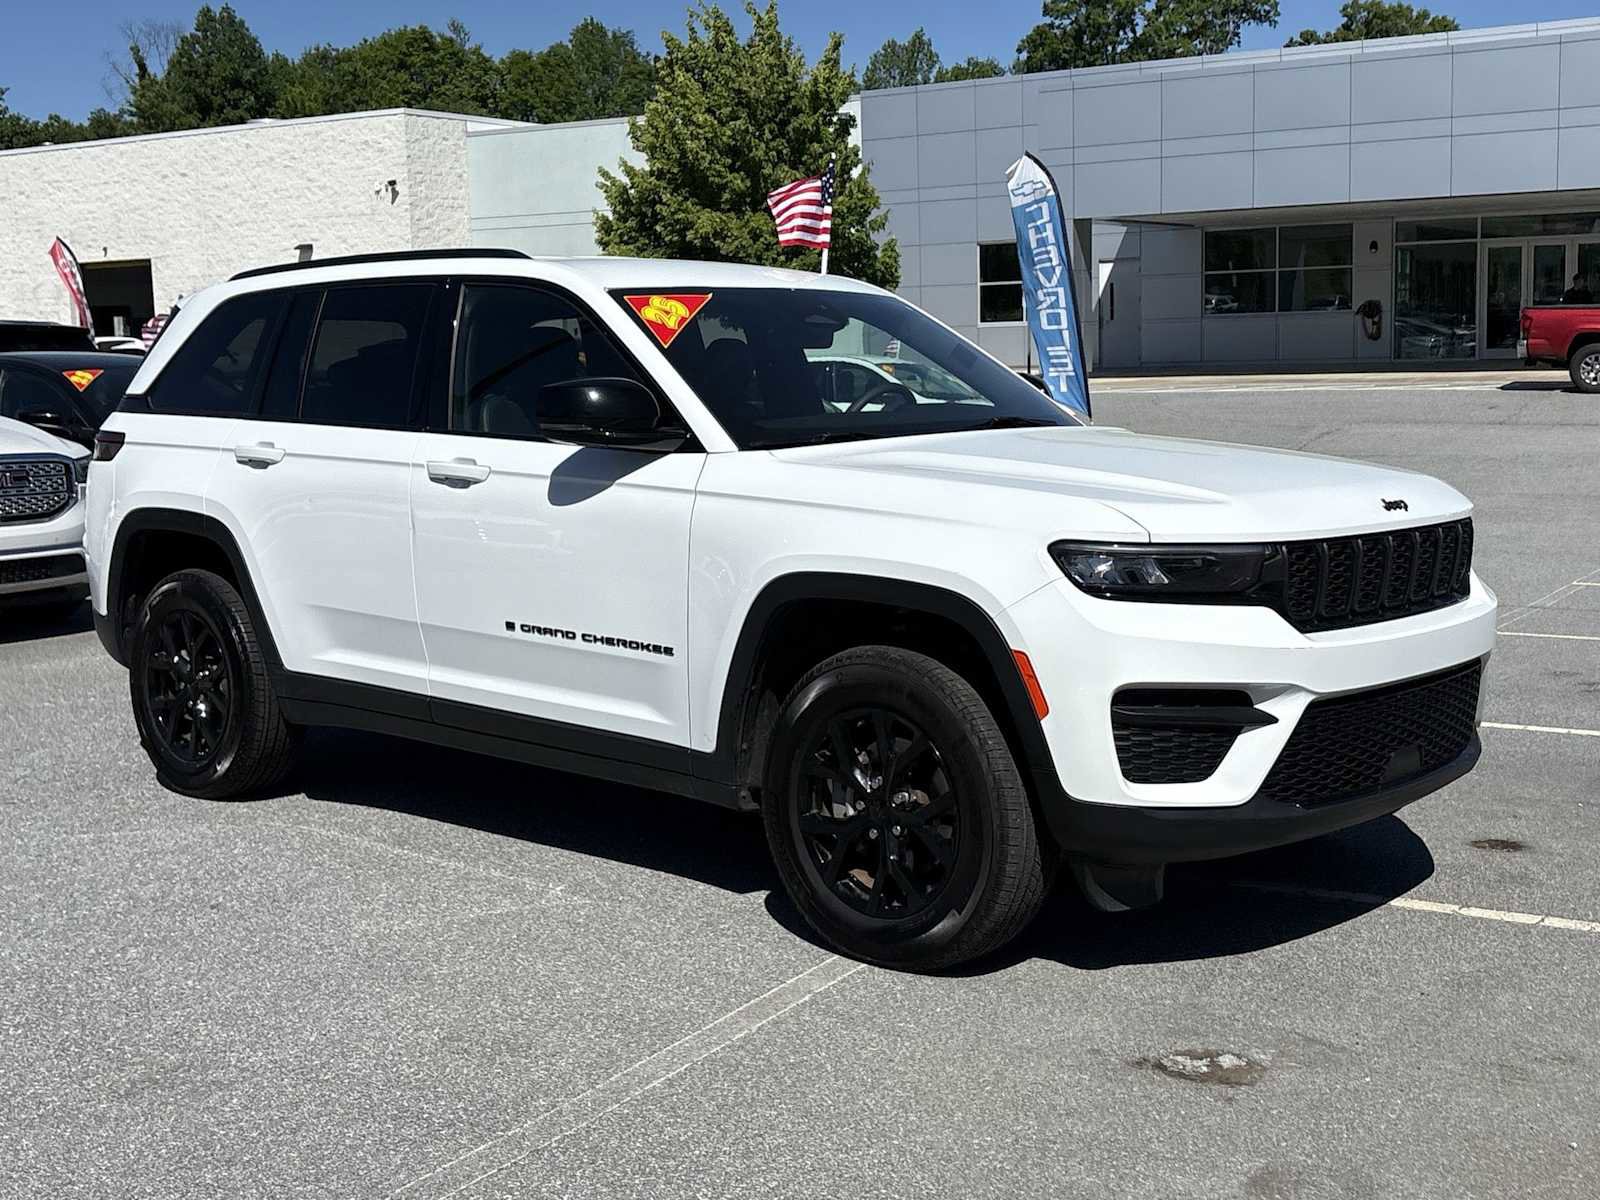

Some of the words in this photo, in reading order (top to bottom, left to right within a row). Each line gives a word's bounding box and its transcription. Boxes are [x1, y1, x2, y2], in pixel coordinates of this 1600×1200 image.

[1381, 498, 1408, 512] Jeep
[520, 623, 577, 640] GRAND
[581, 633, 674, 657] CHEROKEE
